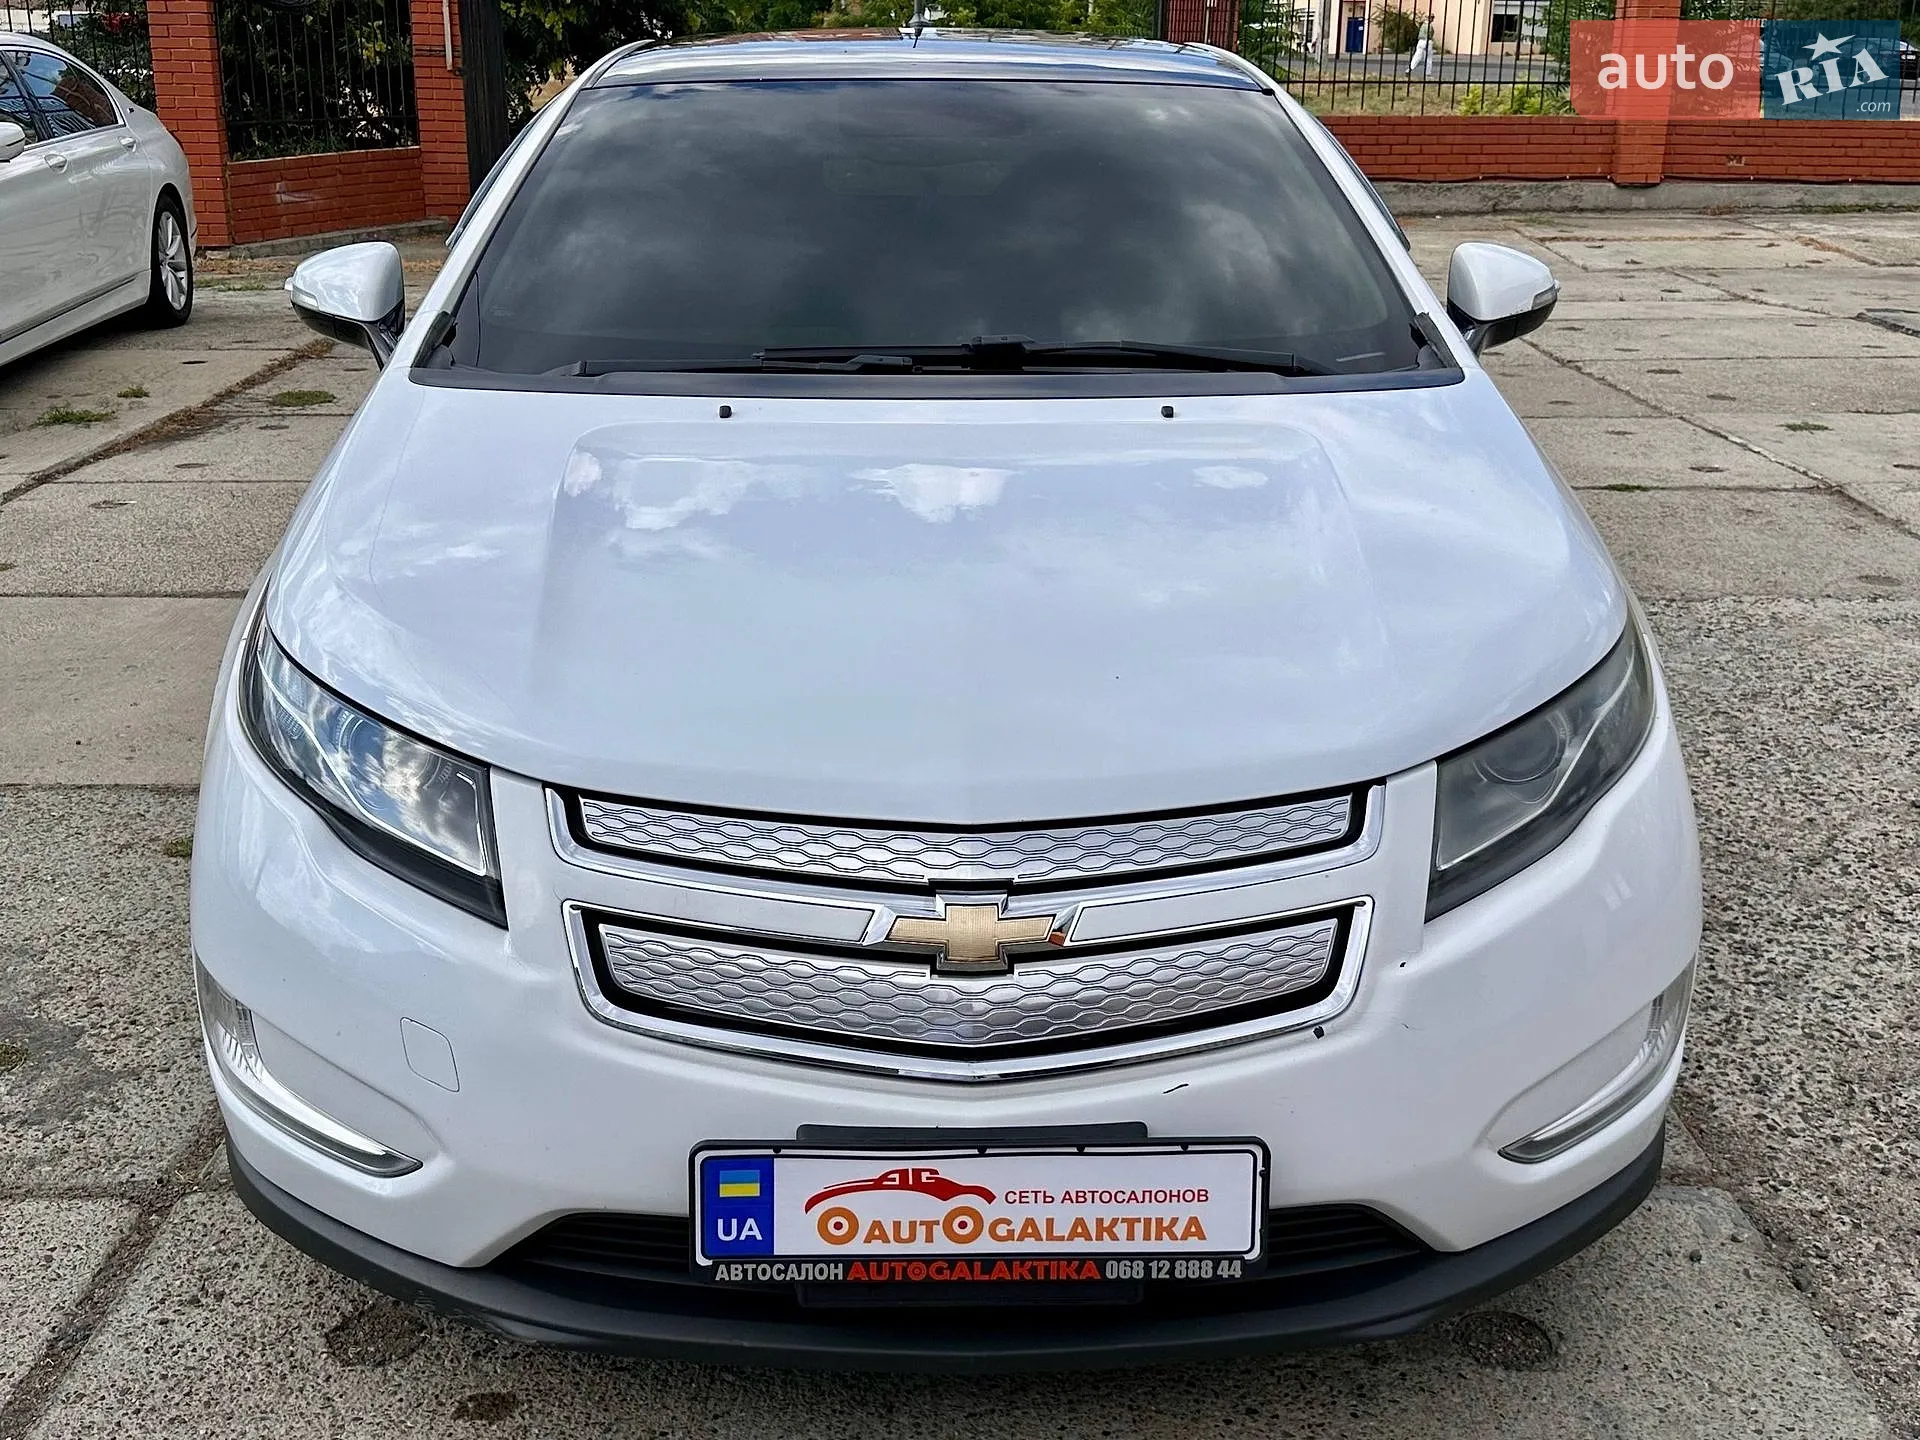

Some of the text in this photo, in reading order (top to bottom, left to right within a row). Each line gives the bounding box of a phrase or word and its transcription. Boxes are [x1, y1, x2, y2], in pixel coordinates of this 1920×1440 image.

[1004, 1189, 1209, 1205] СЕТЬ АВТОСАЛОНОВ
[717, 1218, 763, 1241] UA
[715, 1259, 1242, 1281] АВТОСАЛОН AUTOGALAKTIKA 068 12 888 44
